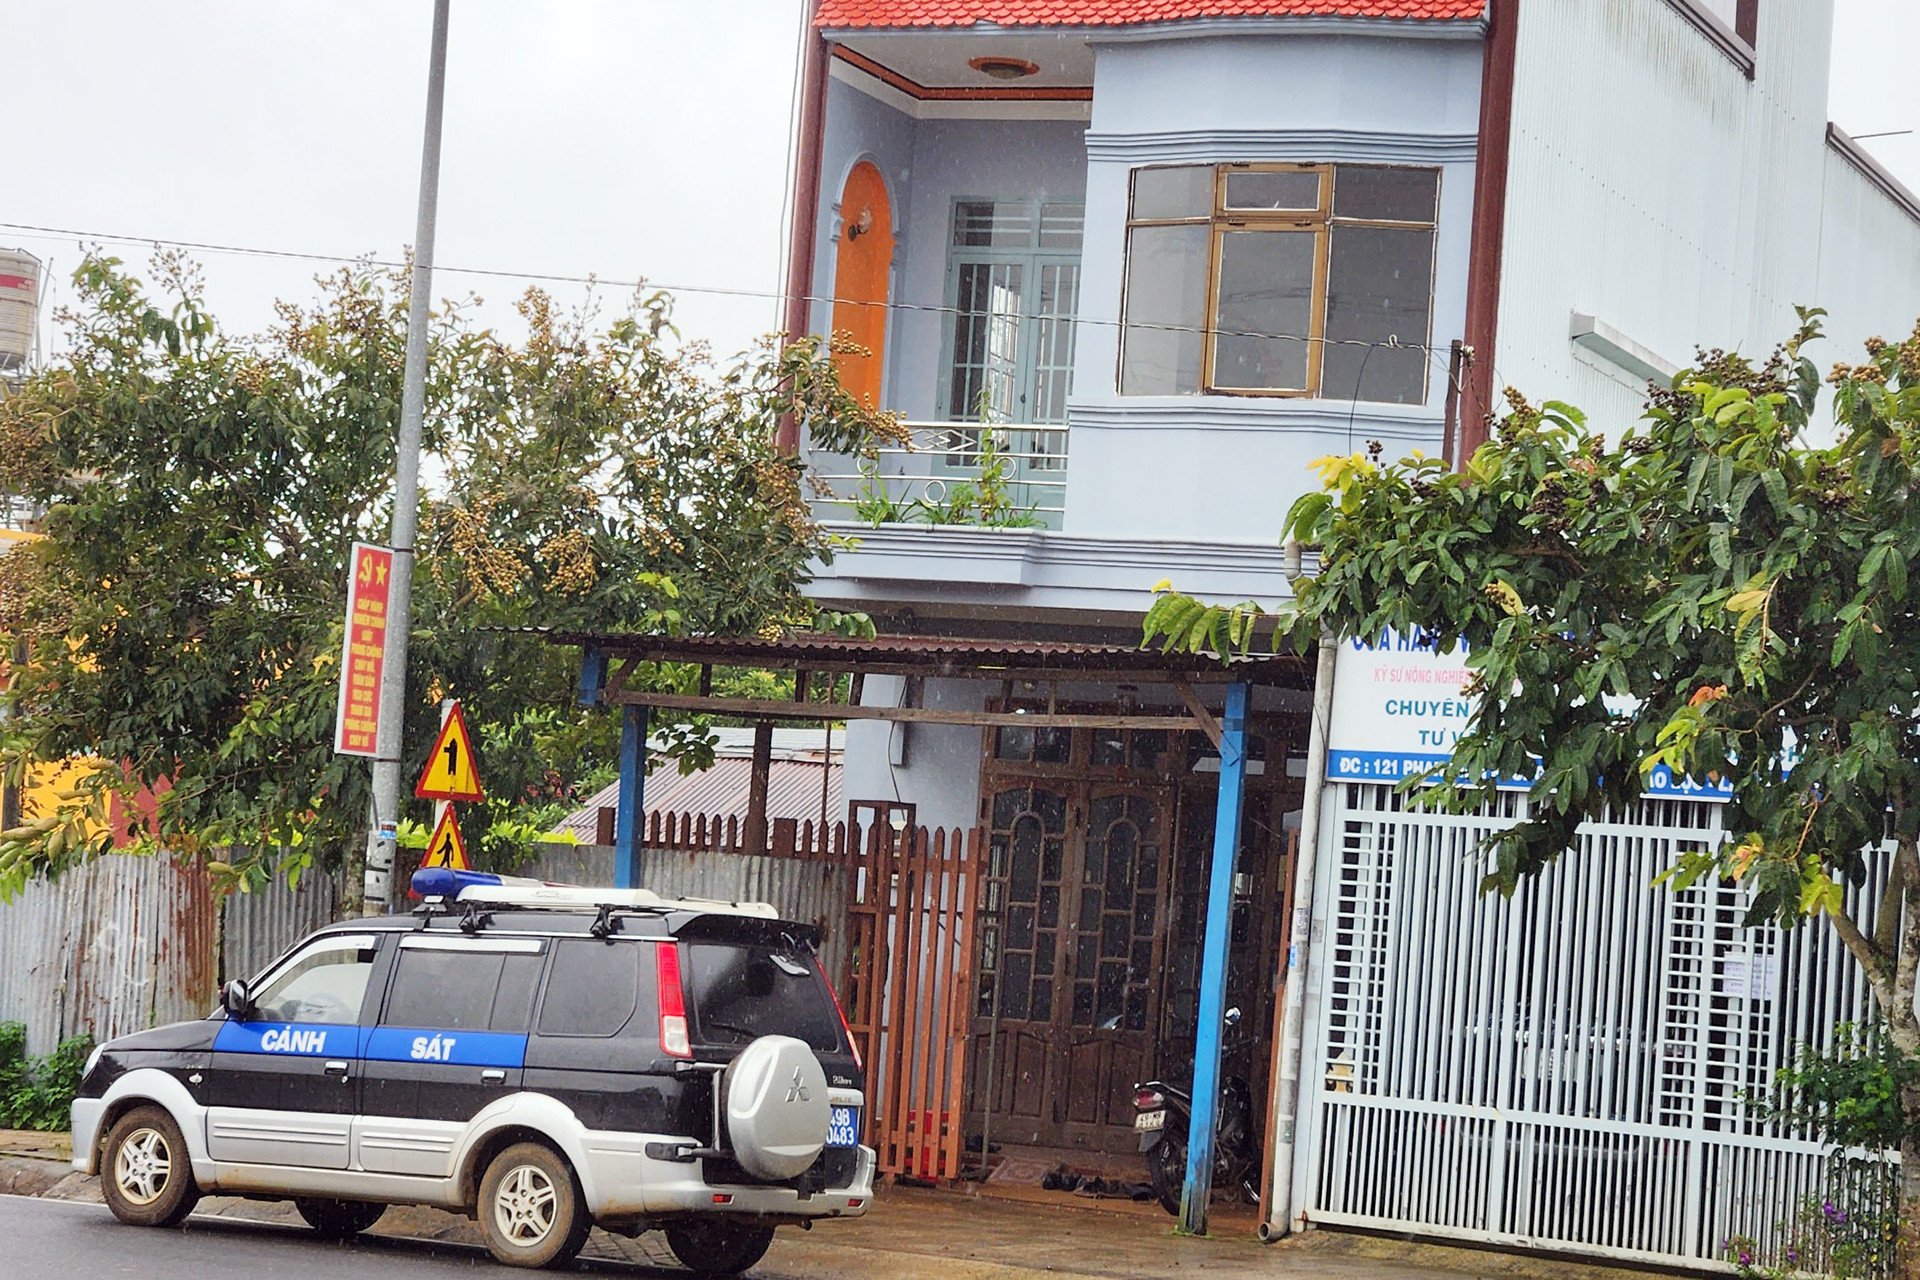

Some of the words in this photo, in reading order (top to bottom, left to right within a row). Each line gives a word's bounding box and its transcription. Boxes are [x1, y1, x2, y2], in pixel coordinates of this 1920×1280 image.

[1385, 698, 1469, 718] CHUYÊN
[1419, 728, 1446, 746] TƯ
[1373, 758, 1398, 775] 121
[260, 1025, 327, 1054] CẢNH
[410, 1034, 456, 1061] SÁT
[826, 1127, 854, 1145] 0483
